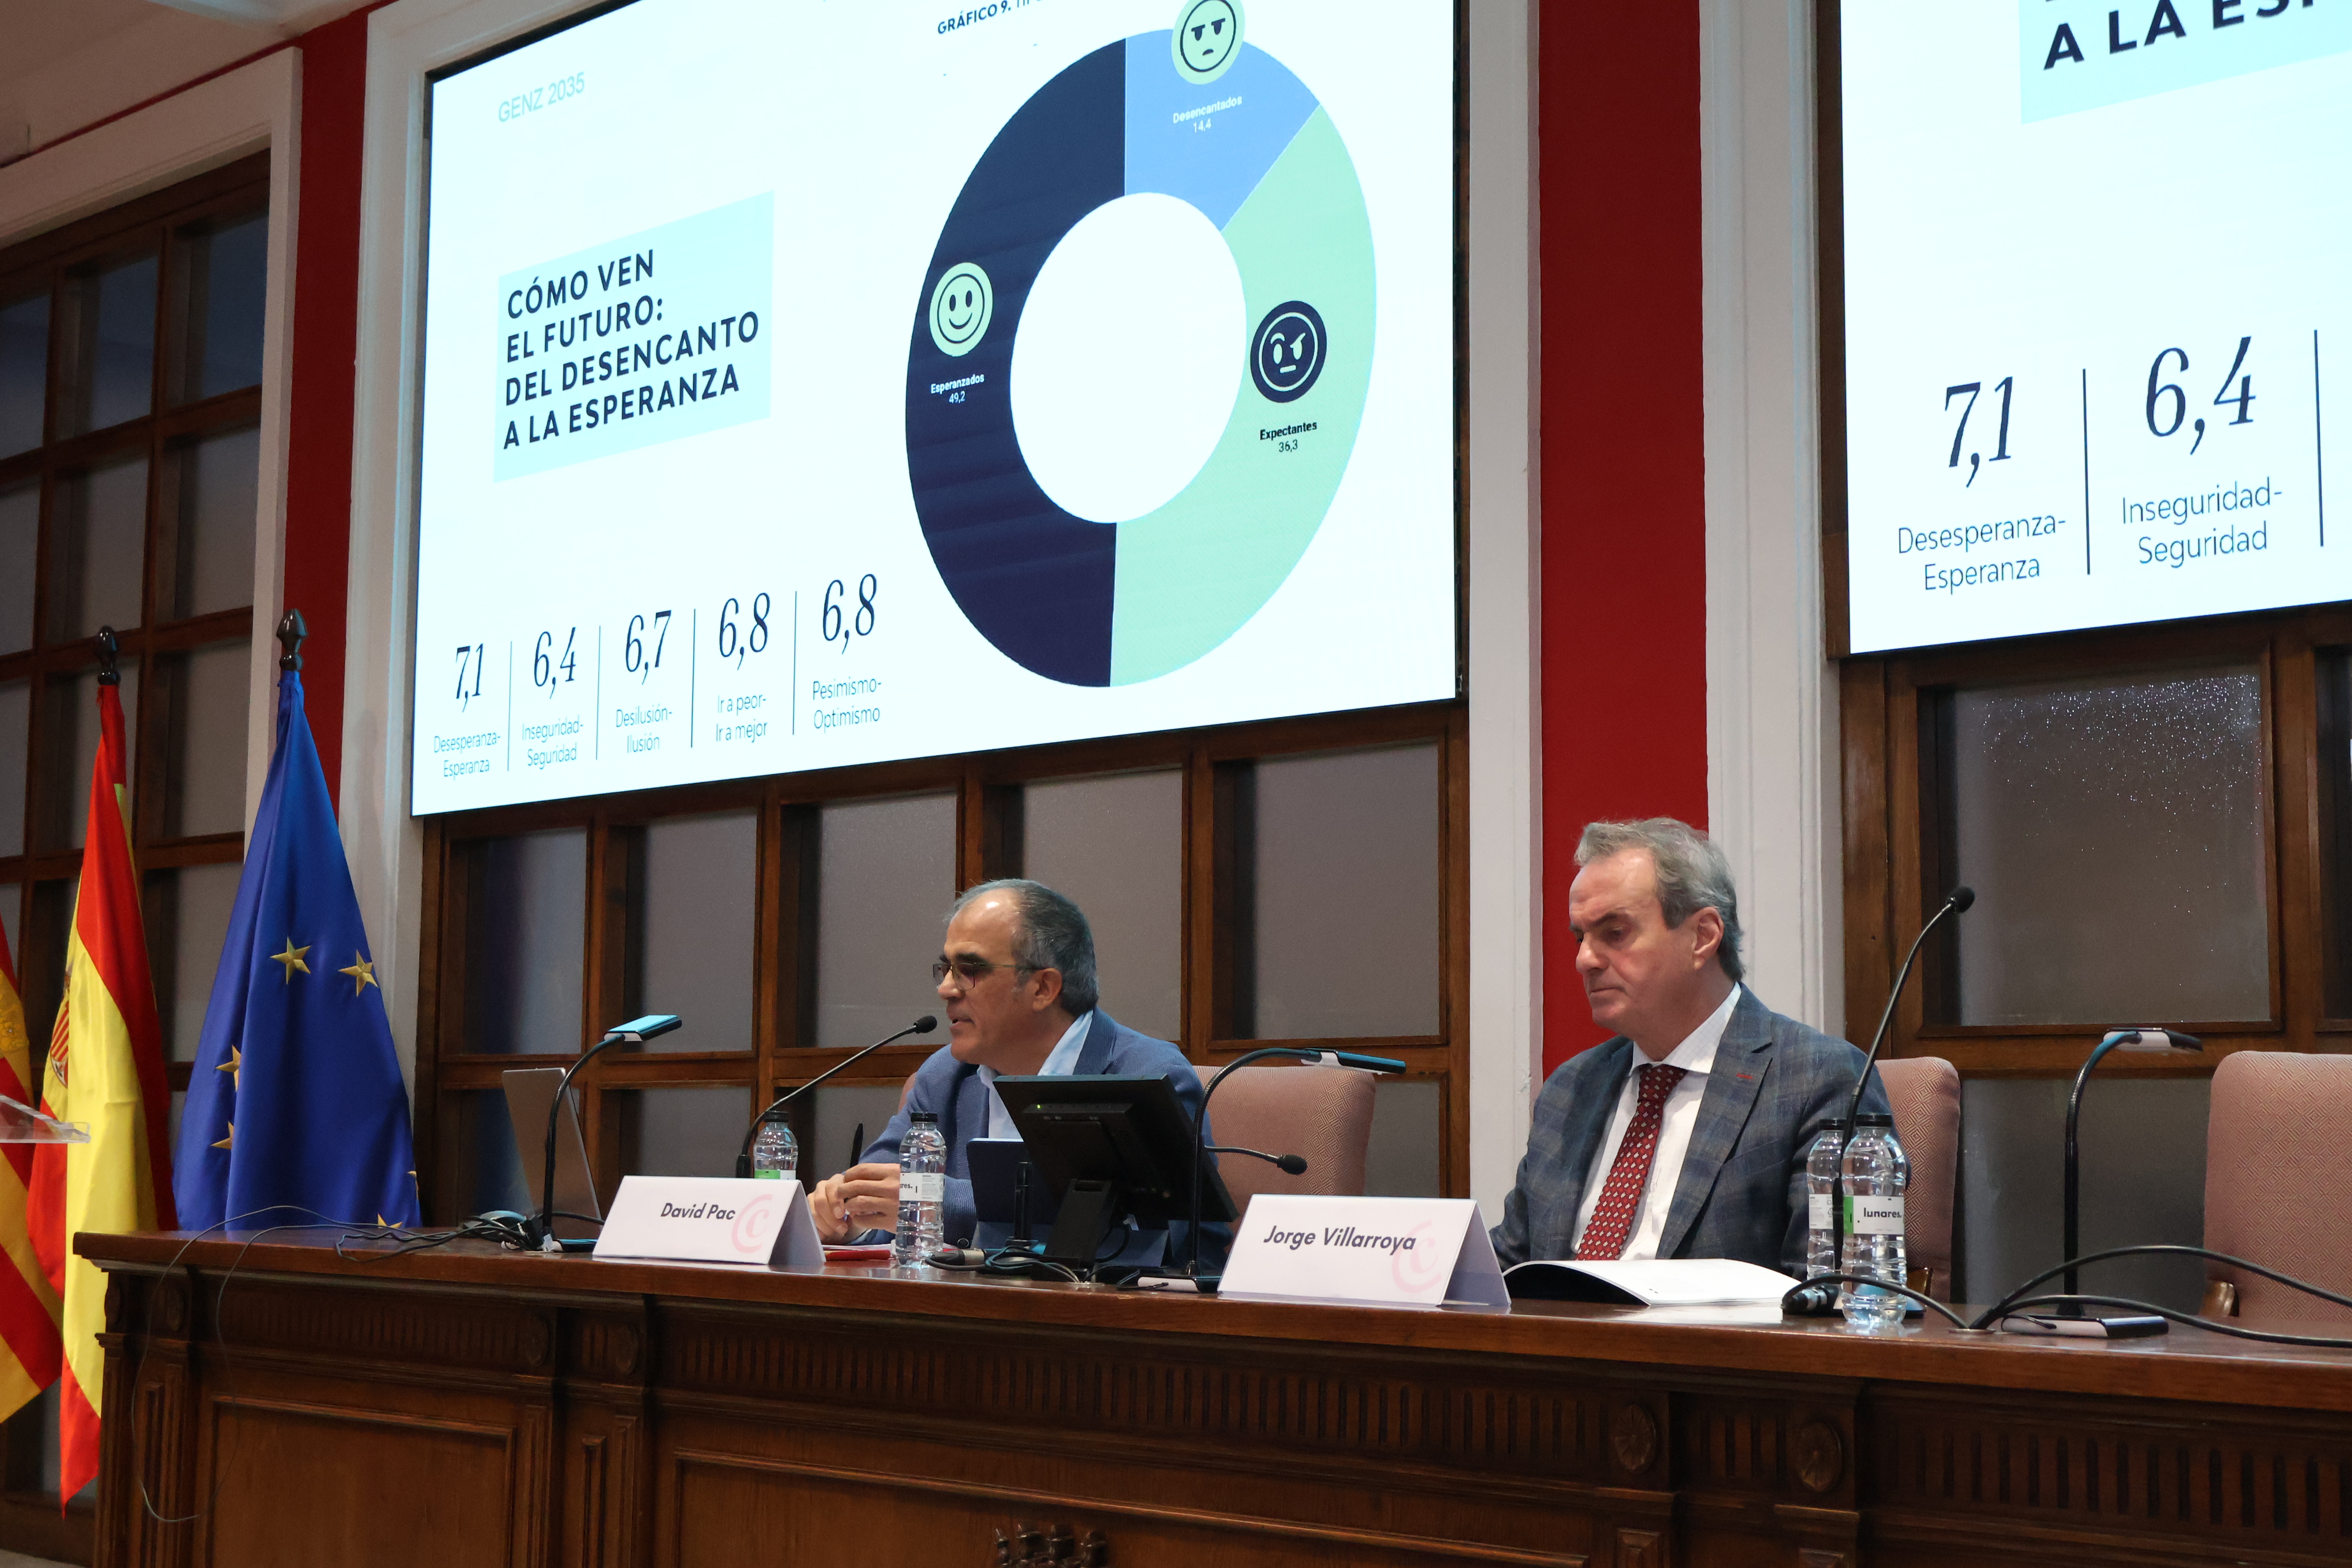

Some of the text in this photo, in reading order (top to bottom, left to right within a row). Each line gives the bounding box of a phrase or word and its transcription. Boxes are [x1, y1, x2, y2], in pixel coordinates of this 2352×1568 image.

[937, 0, 1011, 34] GRÁFICO 9.
[2043, 22, 2085, 71] A
[2108, 0, 2187, 55] LA
[498, 71, 586, 122] GENZ 2035
[1172, 96, 1243, 124] Desencantados
[1193, 118, 1212, 133] 14,4
[507, 249, 654, 319] CÓMO VEN
[507, 295, 664, 363] EL FUTURO:
[505, 311, 759, 407] DEL DESENCANTO
[930, 374, 985, 394] Esperanzados
[949, 391, 965, 403] 49,2
[2145, 335, 2256, 455] 6,4
[503, 363, 740, 450] A LA ESPERANZA
[1260, 422, 1317, 441] Expectantes
[1279, 439, 1298, 452] 36,3
[1943, 376, 2013, 488] 7,1
[2123, 476, 2283, 527] Inseguridad-
[1898, 515, 2066, 554] Desesperanza-
[2139, 521, 2268, 568] Seguridad
[1925, 555, 2040, 595] Esperanza
[822, 573, 877, 655] 6,8
[718, 592, 770, 671] 6,8
[533, 626, 577, 699] 6,4
[625, 610, 672, 685] 6,7
[455, 643, 484, 713] 7,1
[813, 676, 882, 701] Pesimismo-
[616, 704, 672, 728] Desilusión-
[717, 692, 767, 716] Ir a peor-
[522, 714, 583, 743] Inseguridad-
[716, 718, 768, 743] Ir a mejor
[814, 705, 880, 734] Optimismo
[434, 732, 501, 754] Desesperanza-
[527, 741, 577, 769] Seguridad
[627, 733, 660, 754] Ilusión
[443, 759, 489, 780] Esperanza
[660, 1203, 736, 1220] David Pac
[1864, 1207, 1902, 1219] lunares.
[1263, 1226, 1416, 1256] Jorge Villarroya
